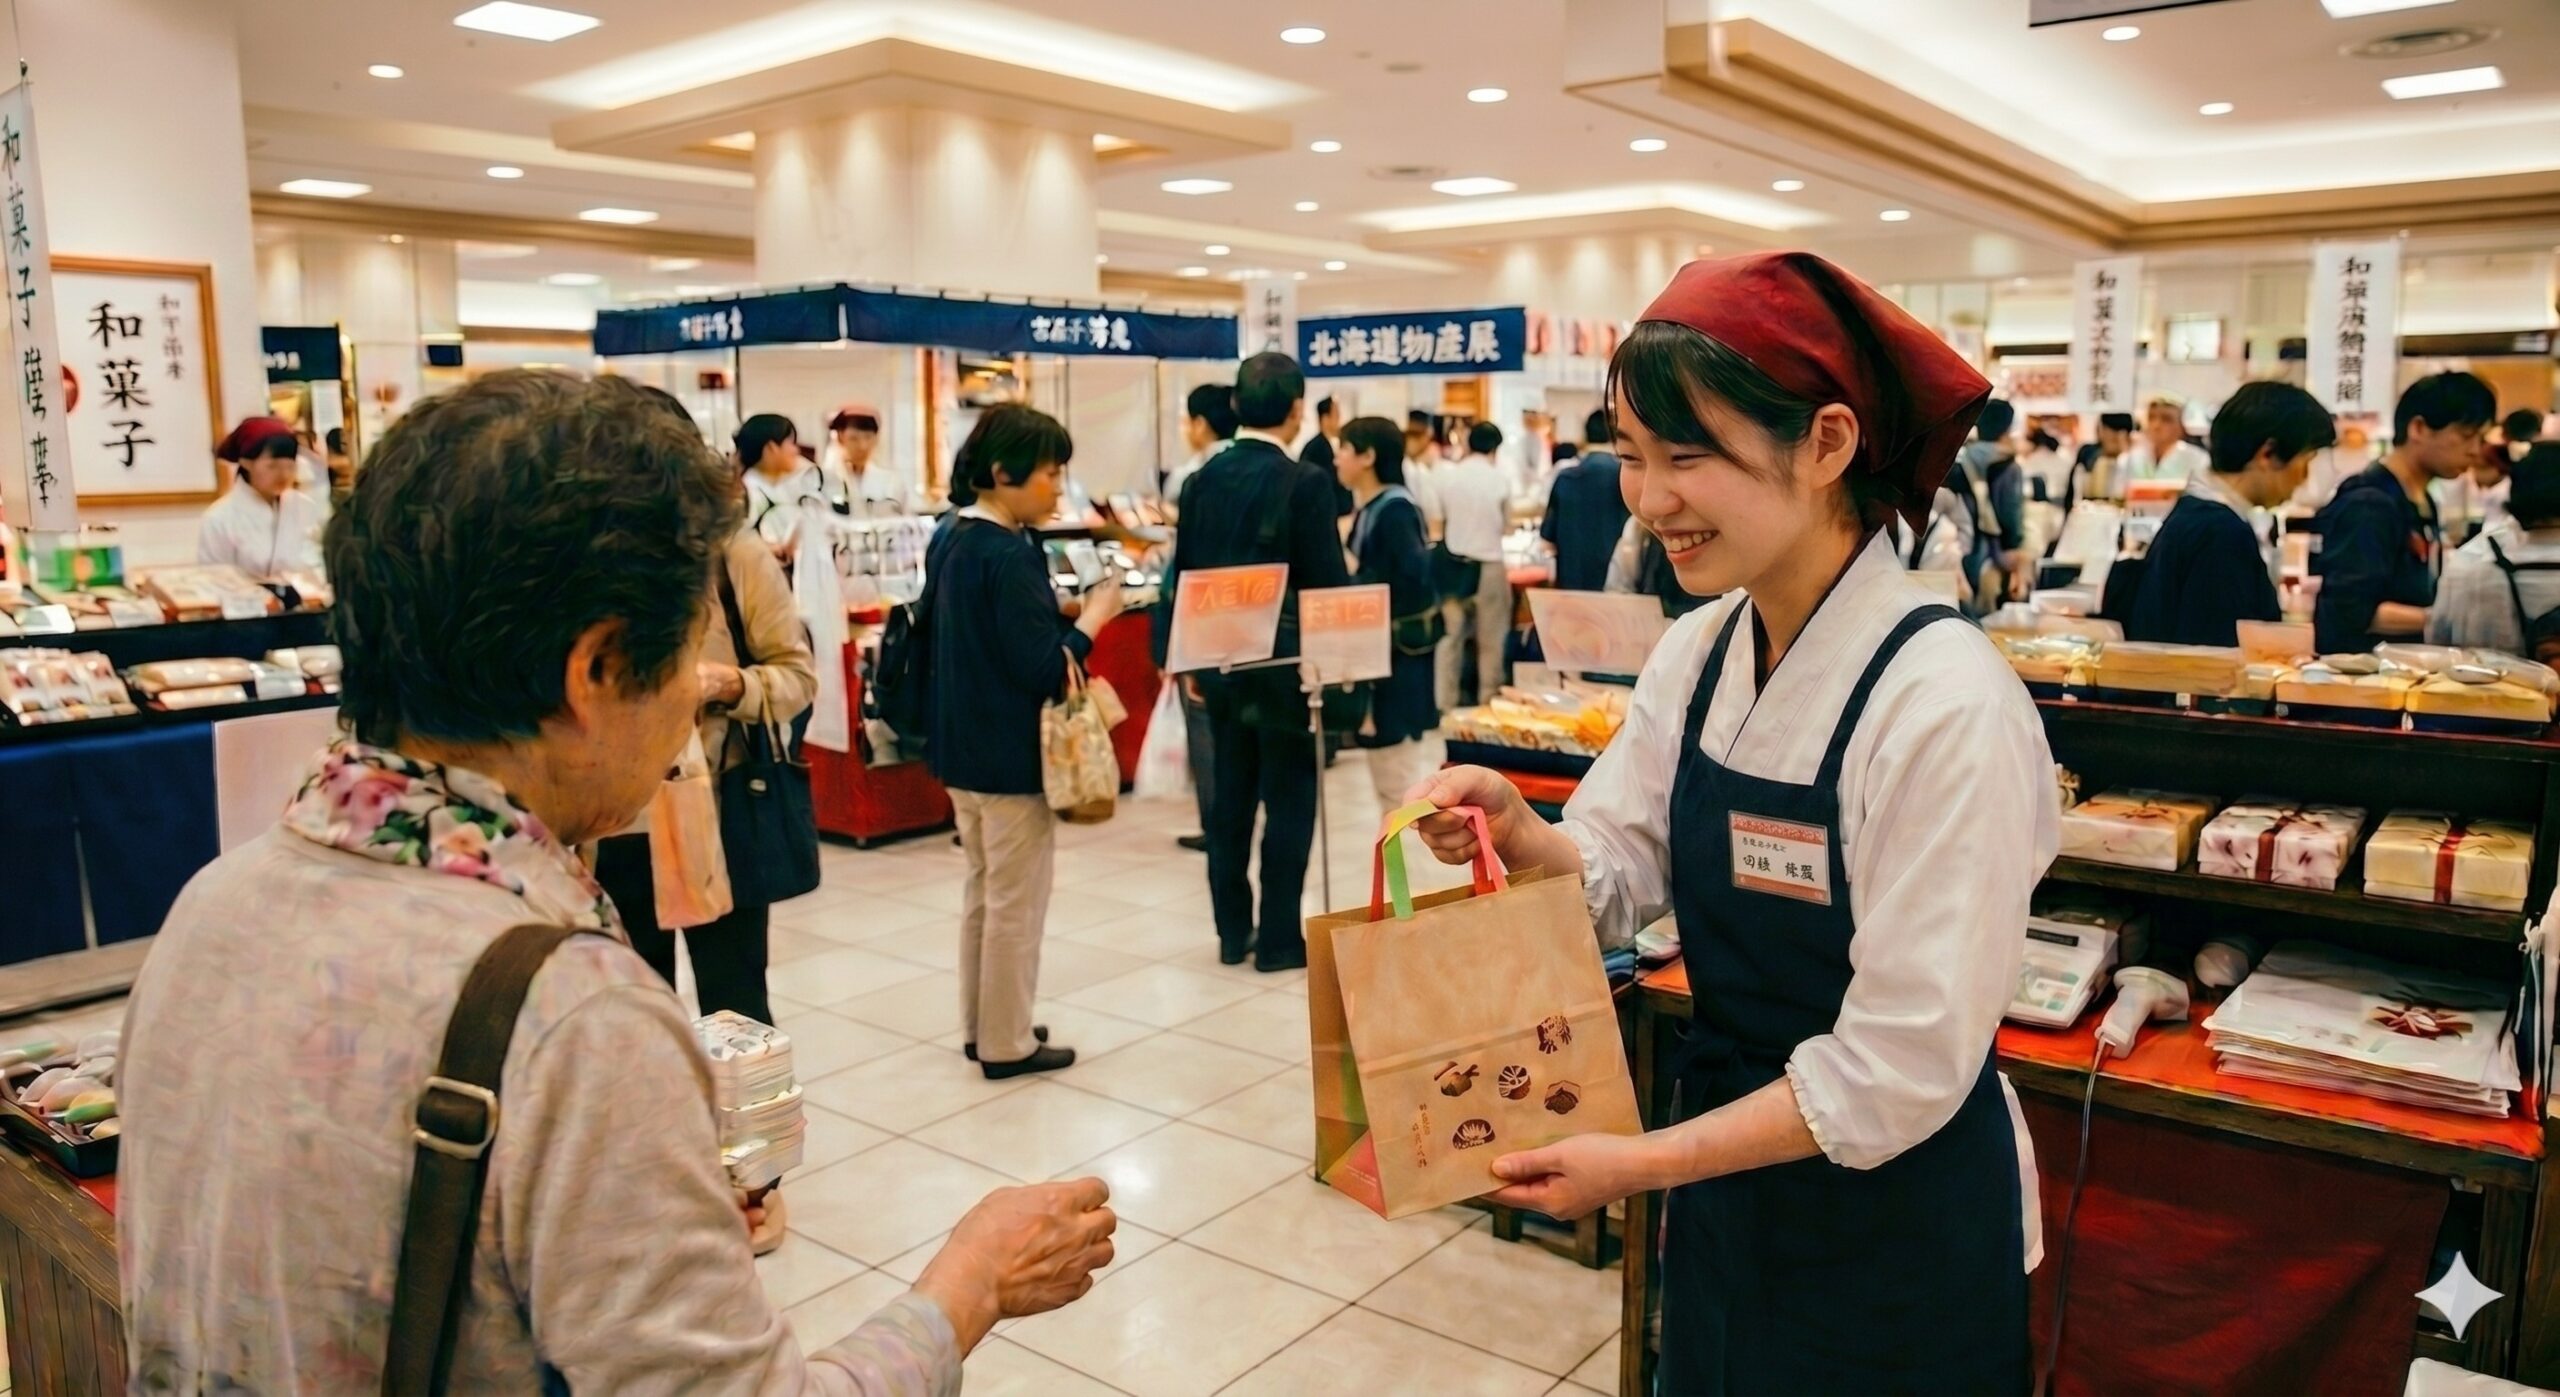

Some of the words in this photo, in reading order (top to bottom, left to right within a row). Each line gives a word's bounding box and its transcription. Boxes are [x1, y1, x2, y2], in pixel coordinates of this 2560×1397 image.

[87, 302, 156, 469] 和菓子
[1309, 320, 1501, 368] 北海道物産展
